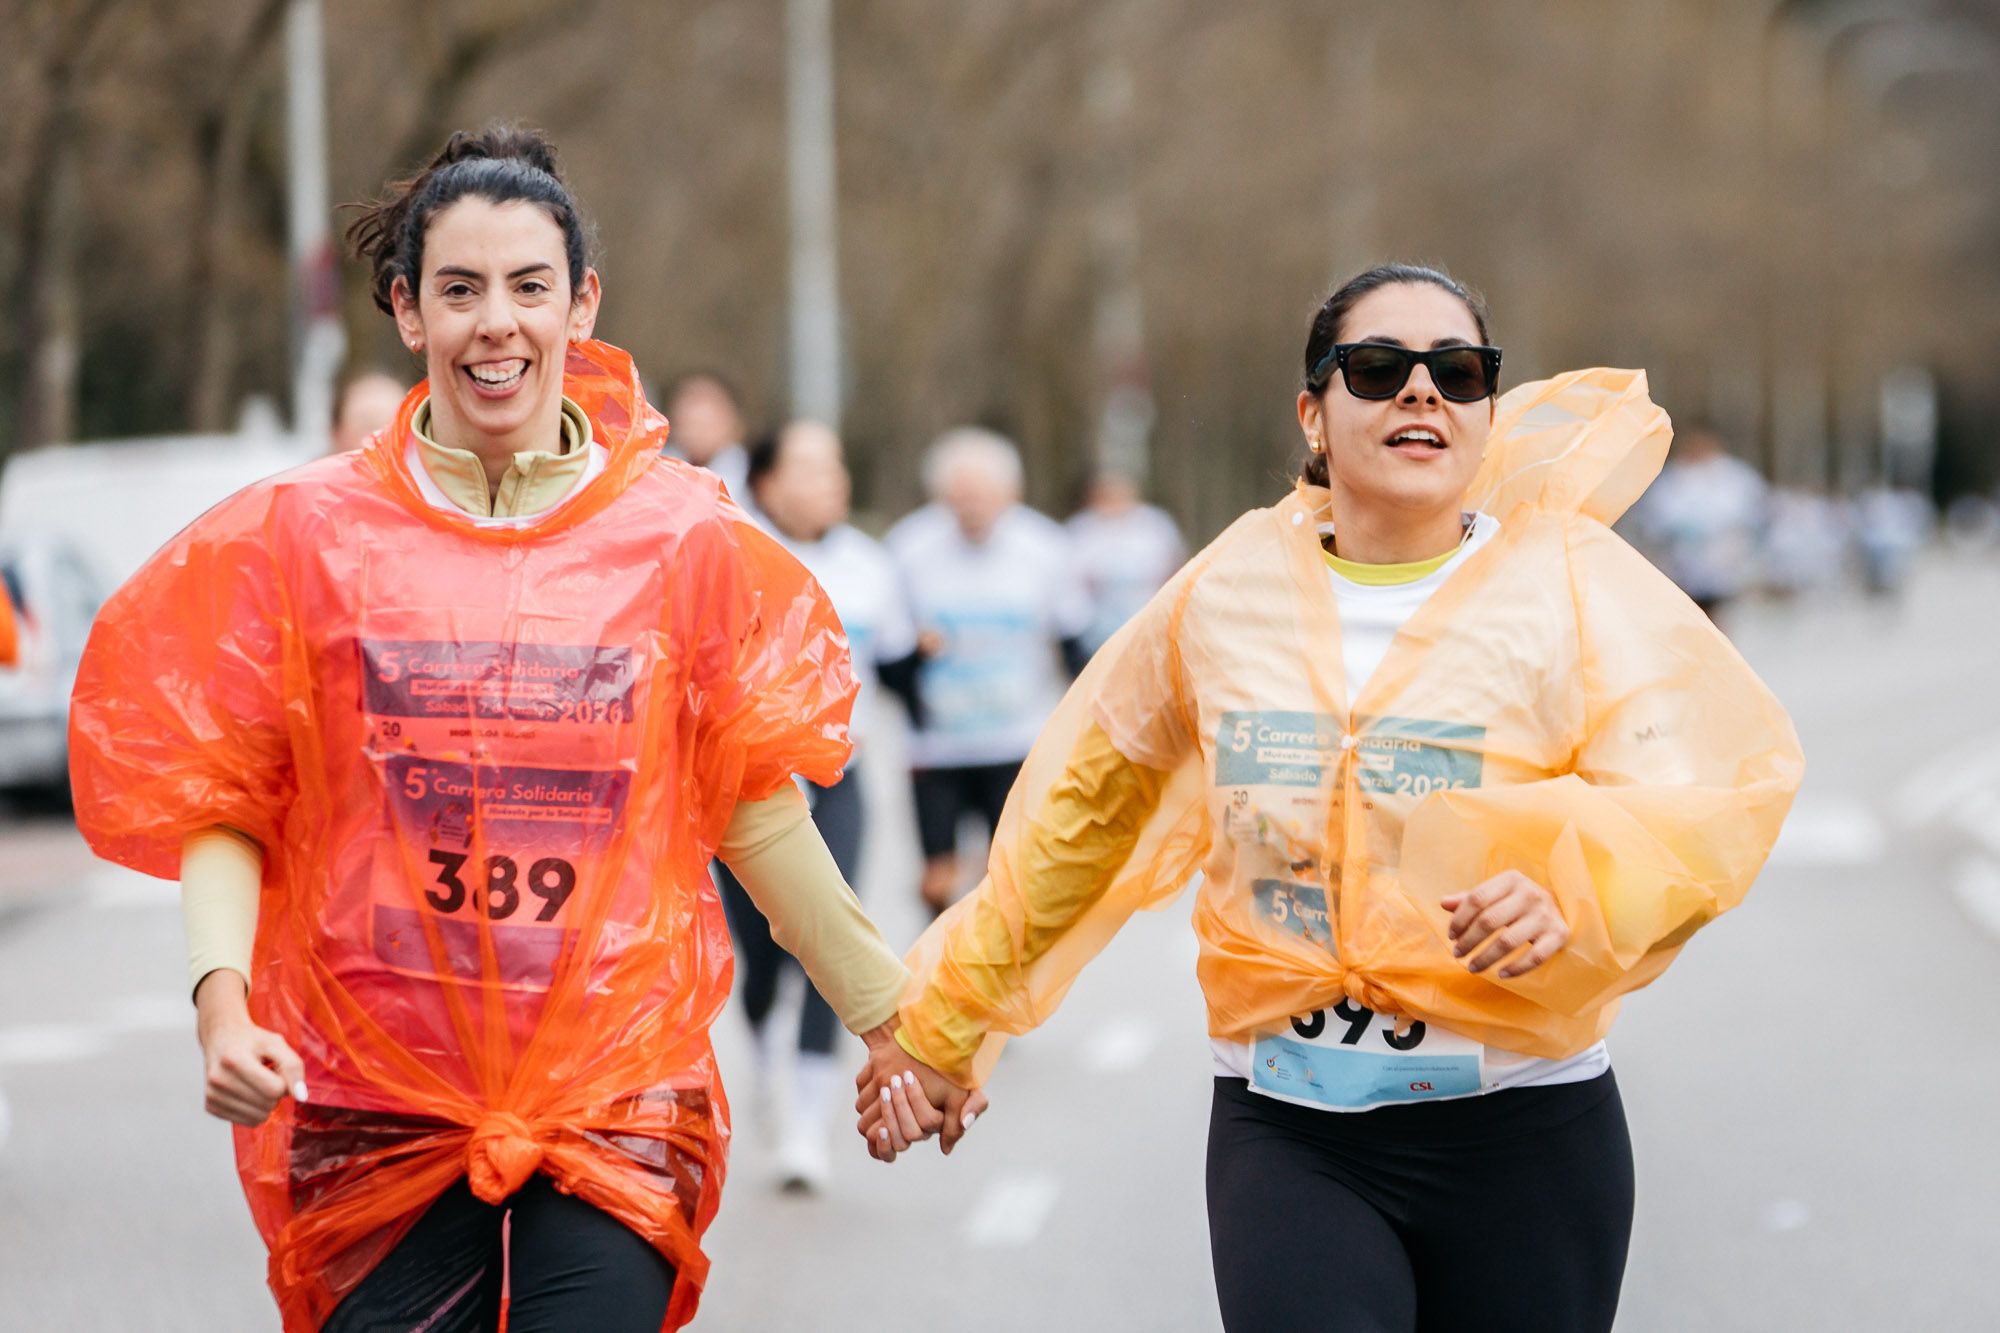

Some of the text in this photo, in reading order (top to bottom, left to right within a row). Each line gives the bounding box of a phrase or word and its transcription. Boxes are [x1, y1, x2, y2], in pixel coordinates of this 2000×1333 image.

[408, 657, 485, 675] Carrera
[494, 659, 579, 679] Solidaria
[561, 700, 624, 723] 2026
[433, 777, 505, 799] Carrera
[511, 783, 593, 802] Solidaria
[425, 849, 576, 922] 389
[1409, 1081, 1435, 1092] CSL
